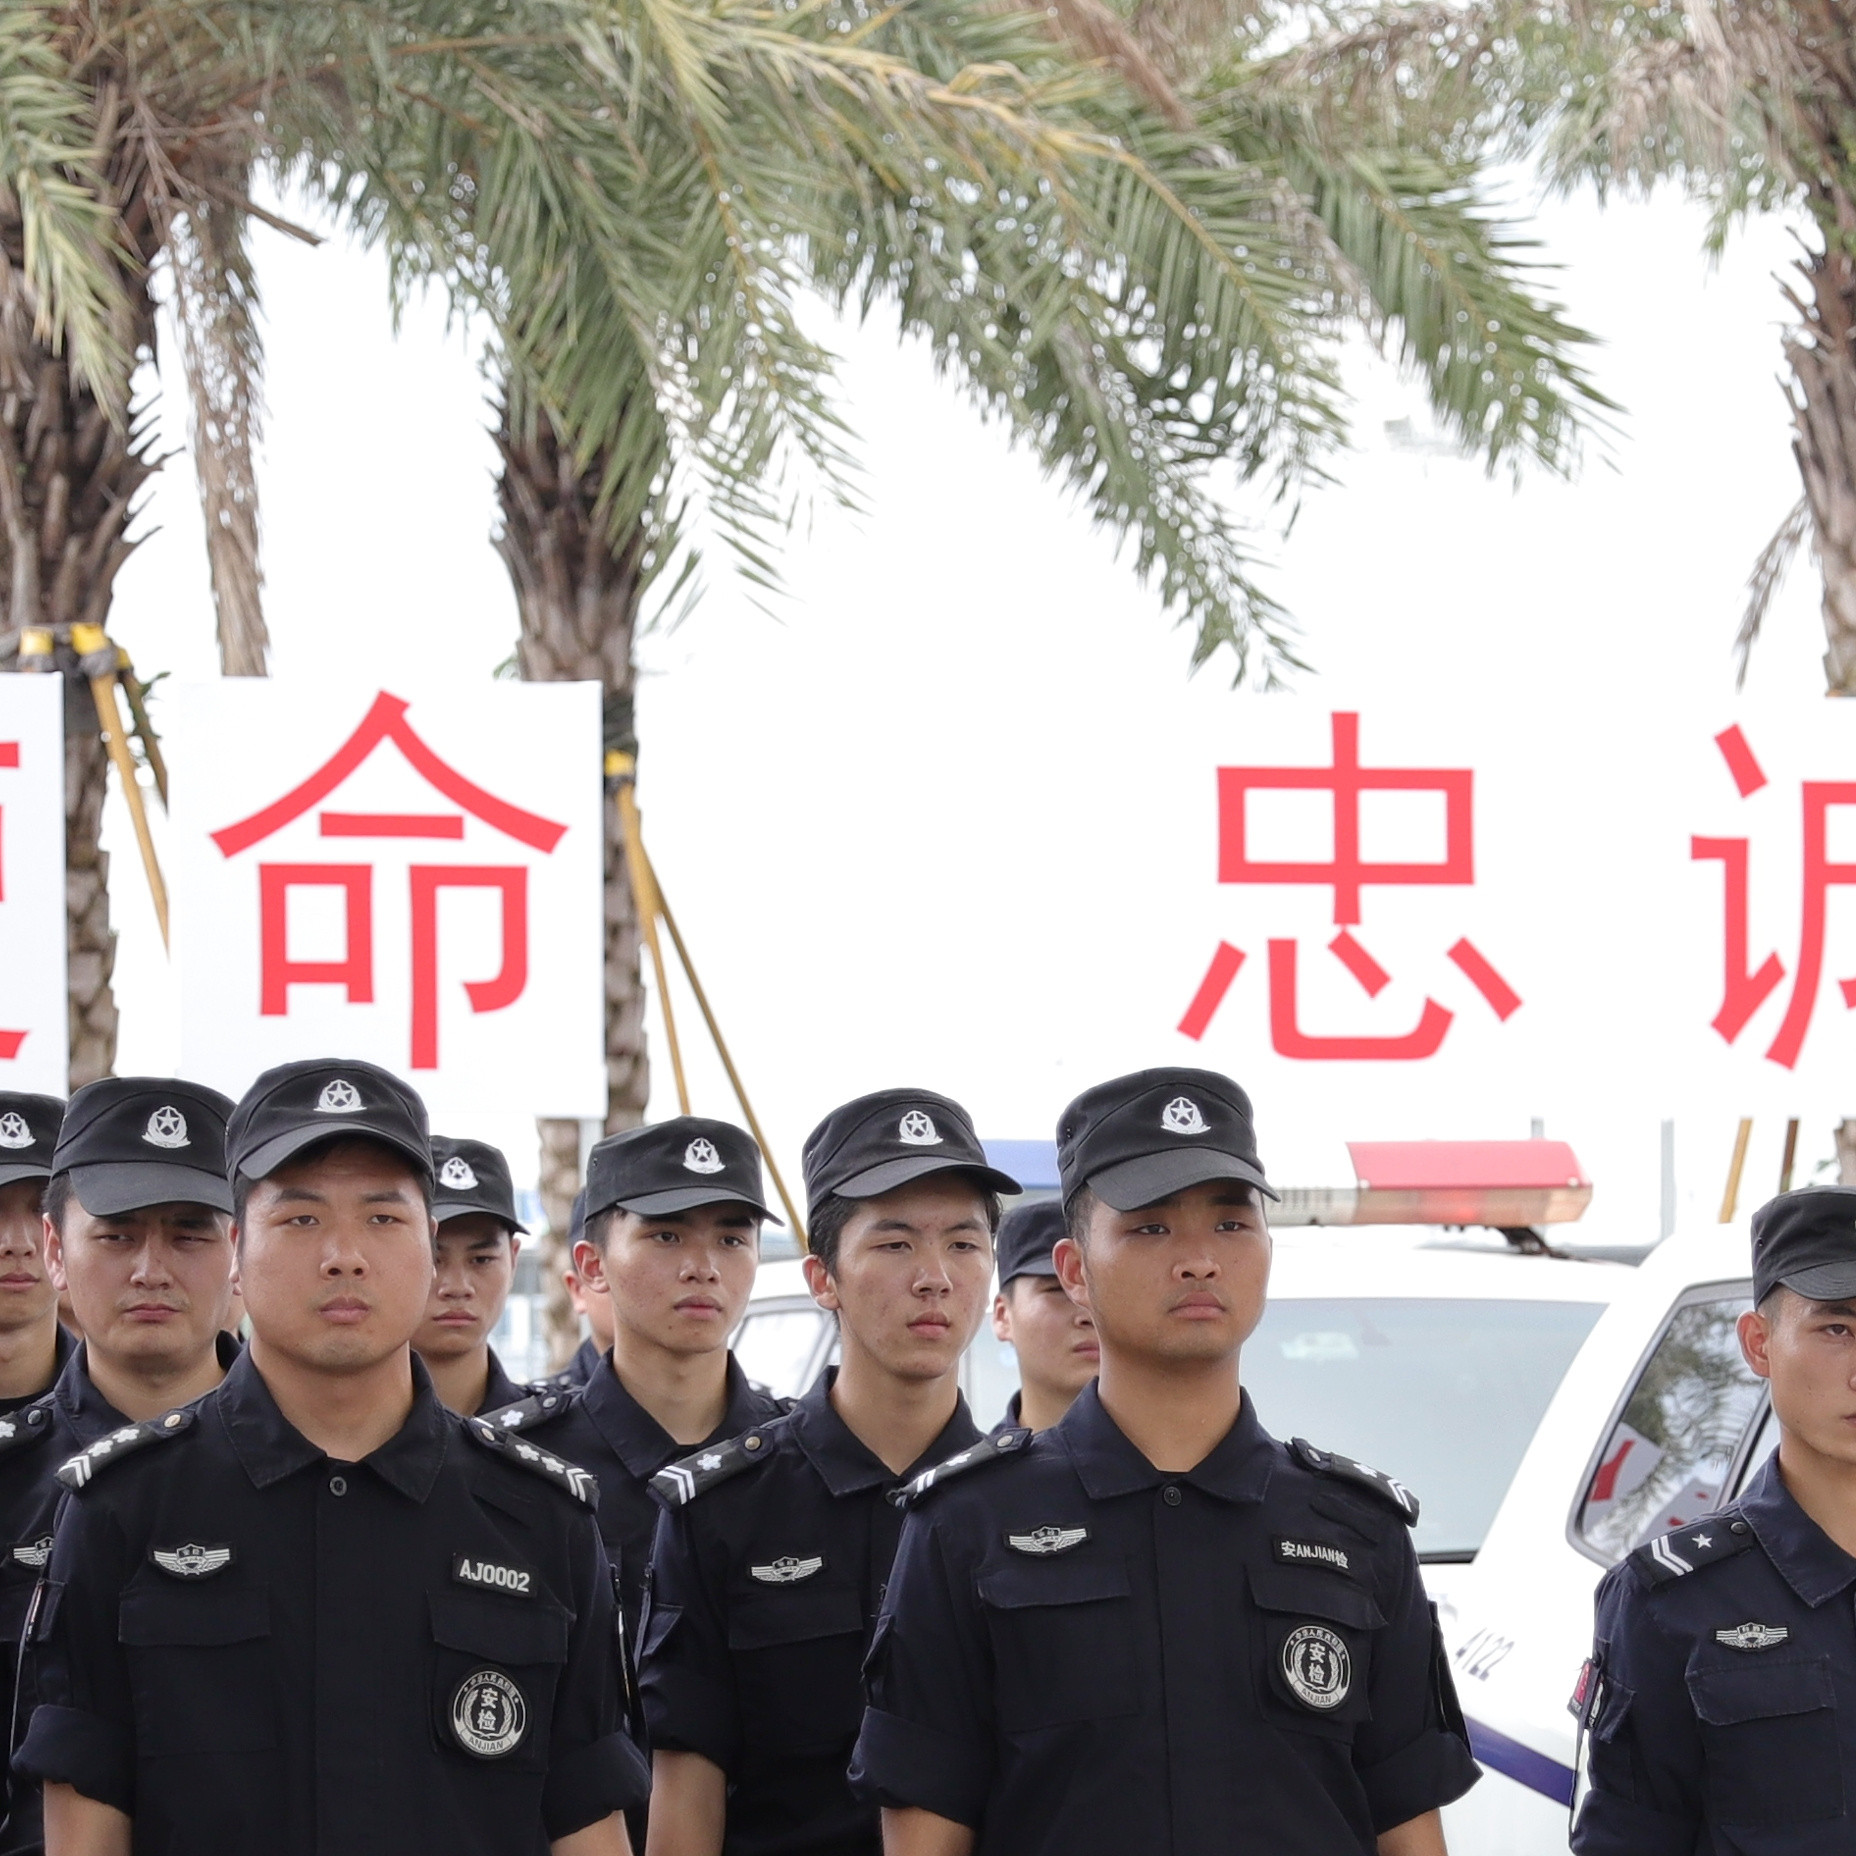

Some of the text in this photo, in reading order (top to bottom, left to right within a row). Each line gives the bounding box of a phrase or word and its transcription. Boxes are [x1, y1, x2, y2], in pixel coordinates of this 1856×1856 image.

[459, 1558, 531, 1593] AJ0002
[1308, 1641, 1326, 1685] 安检
[476, 1687, 499, 1732] 安检
[469, 1735, 504, 1752] ANJIAN
